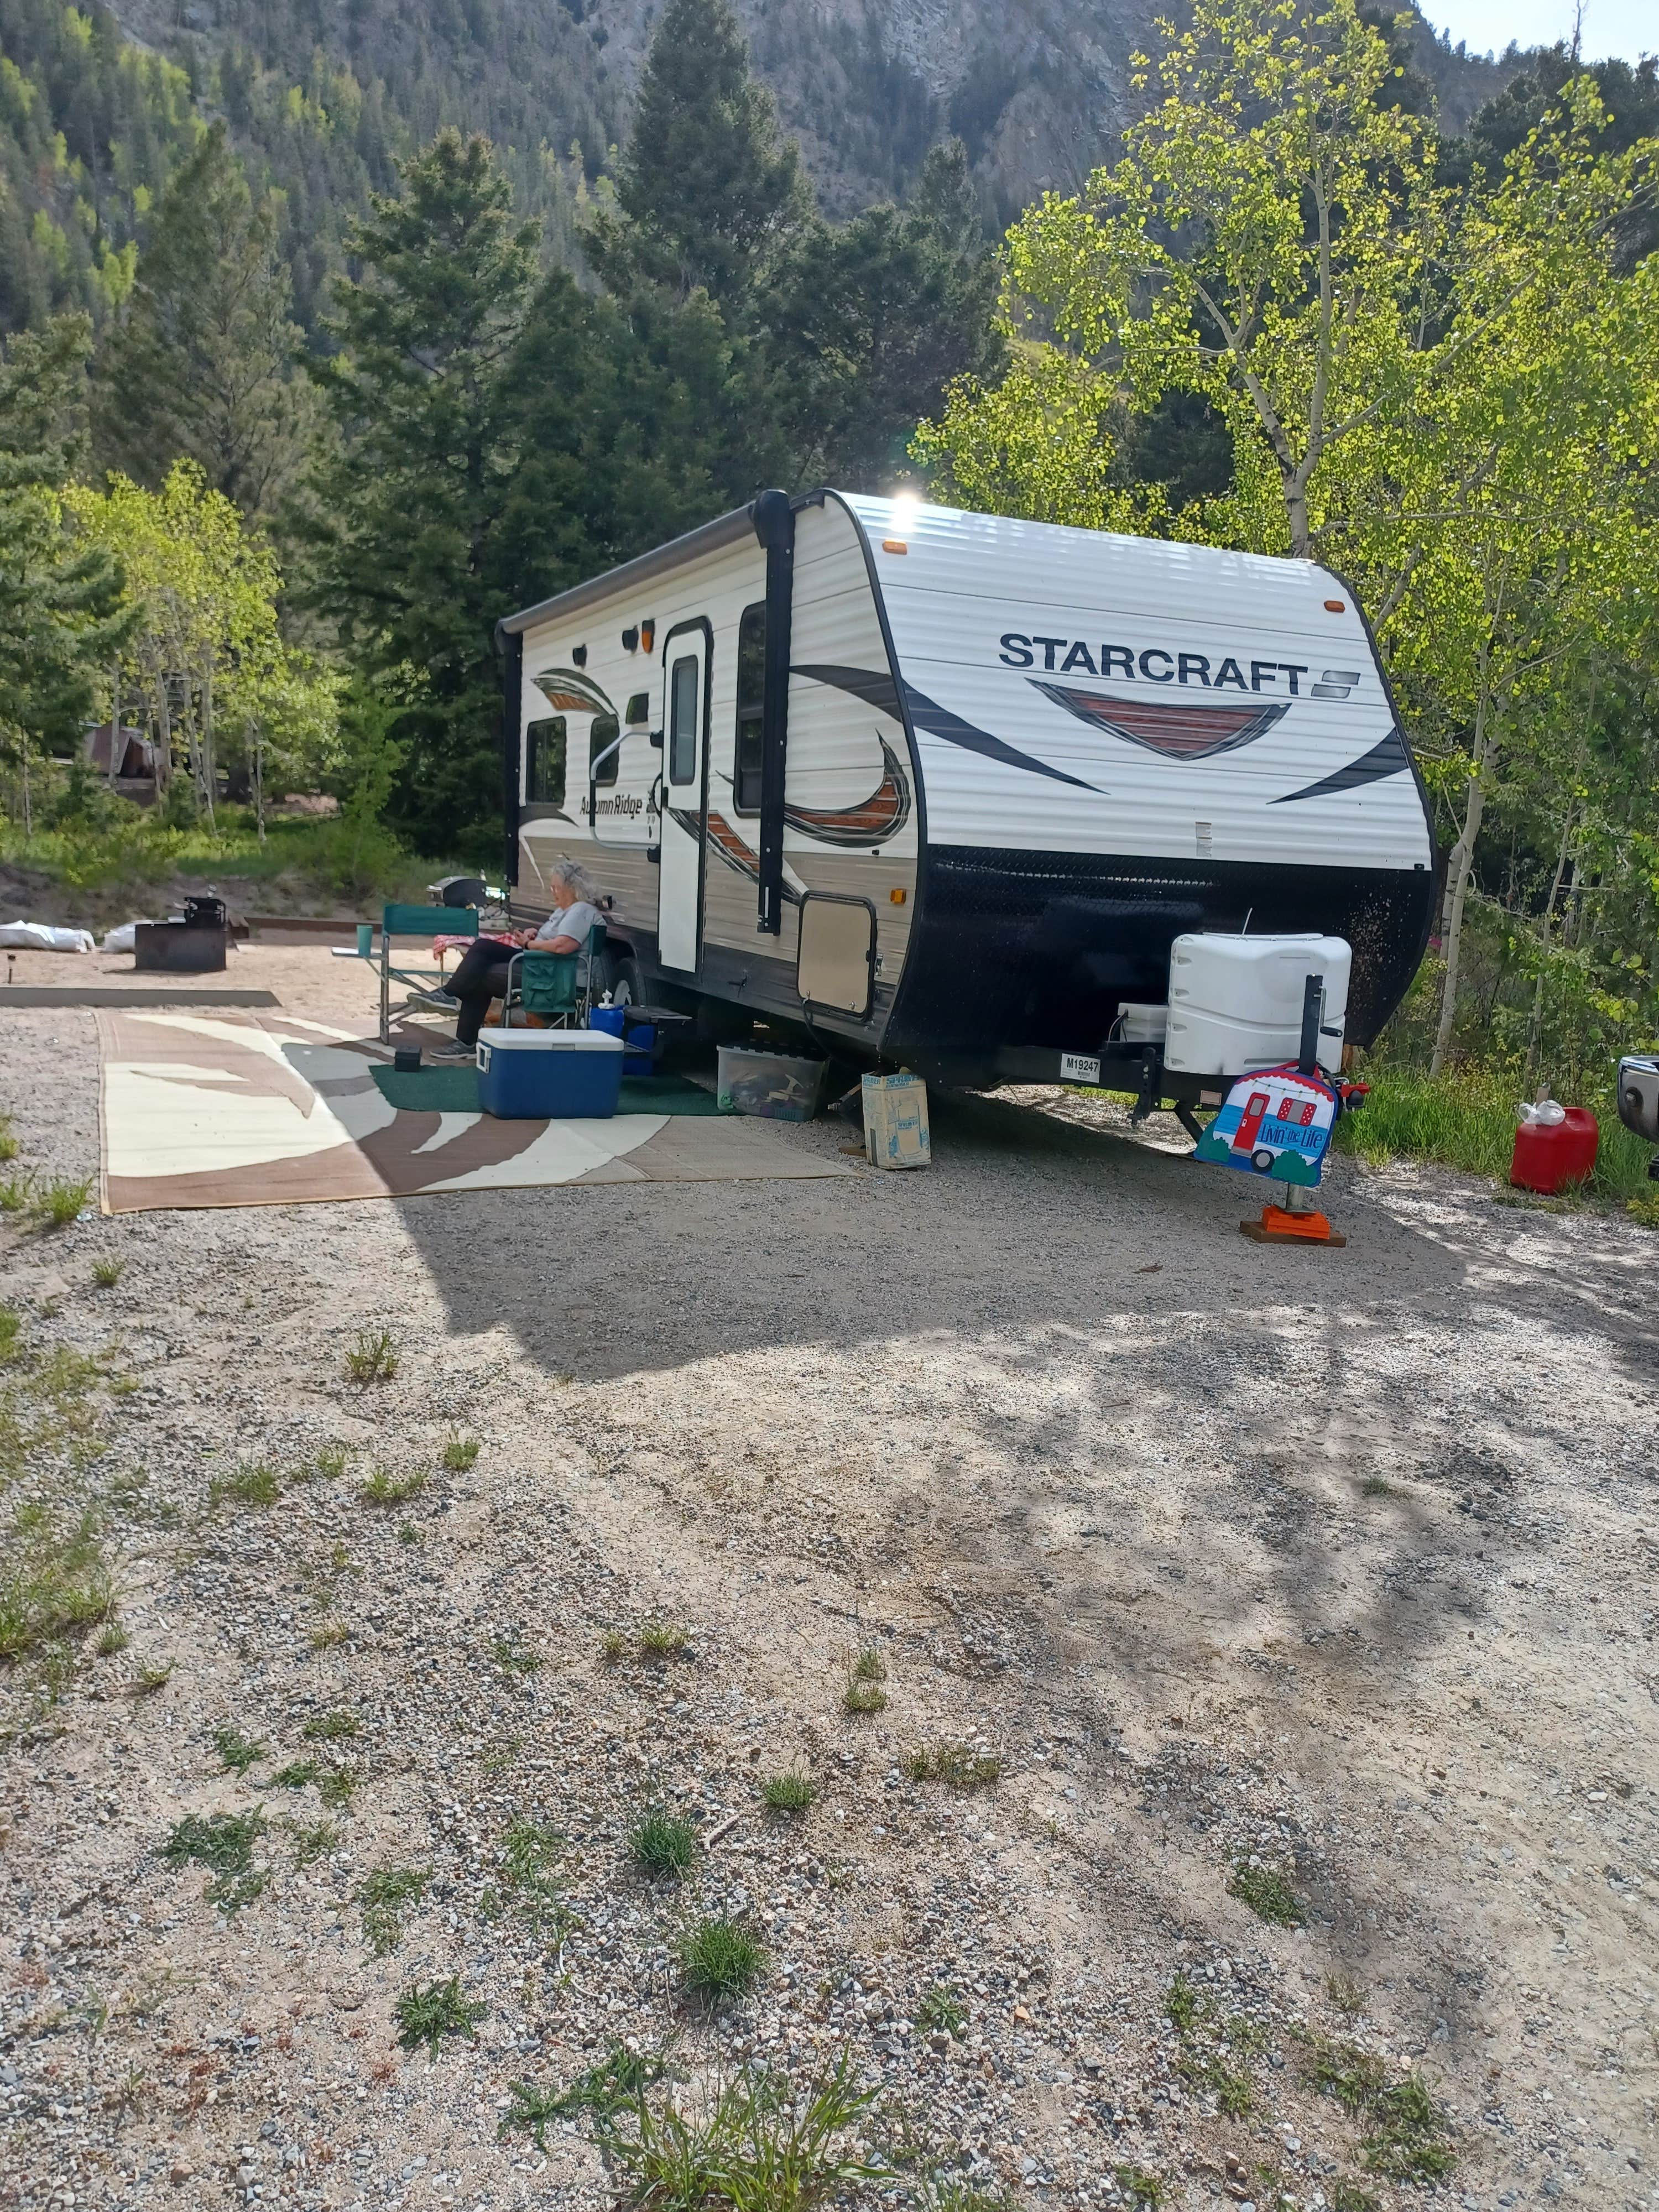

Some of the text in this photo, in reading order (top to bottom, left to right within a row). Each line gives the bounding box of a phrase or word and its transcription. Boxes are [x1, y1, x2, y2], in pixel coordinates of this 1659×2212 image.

[999, 633, 1308, 695] STARCRAFT
[1067, 1057, 1099, 1072] M19247
[1260, 1123, 1323, 1149] Livin' the Life
